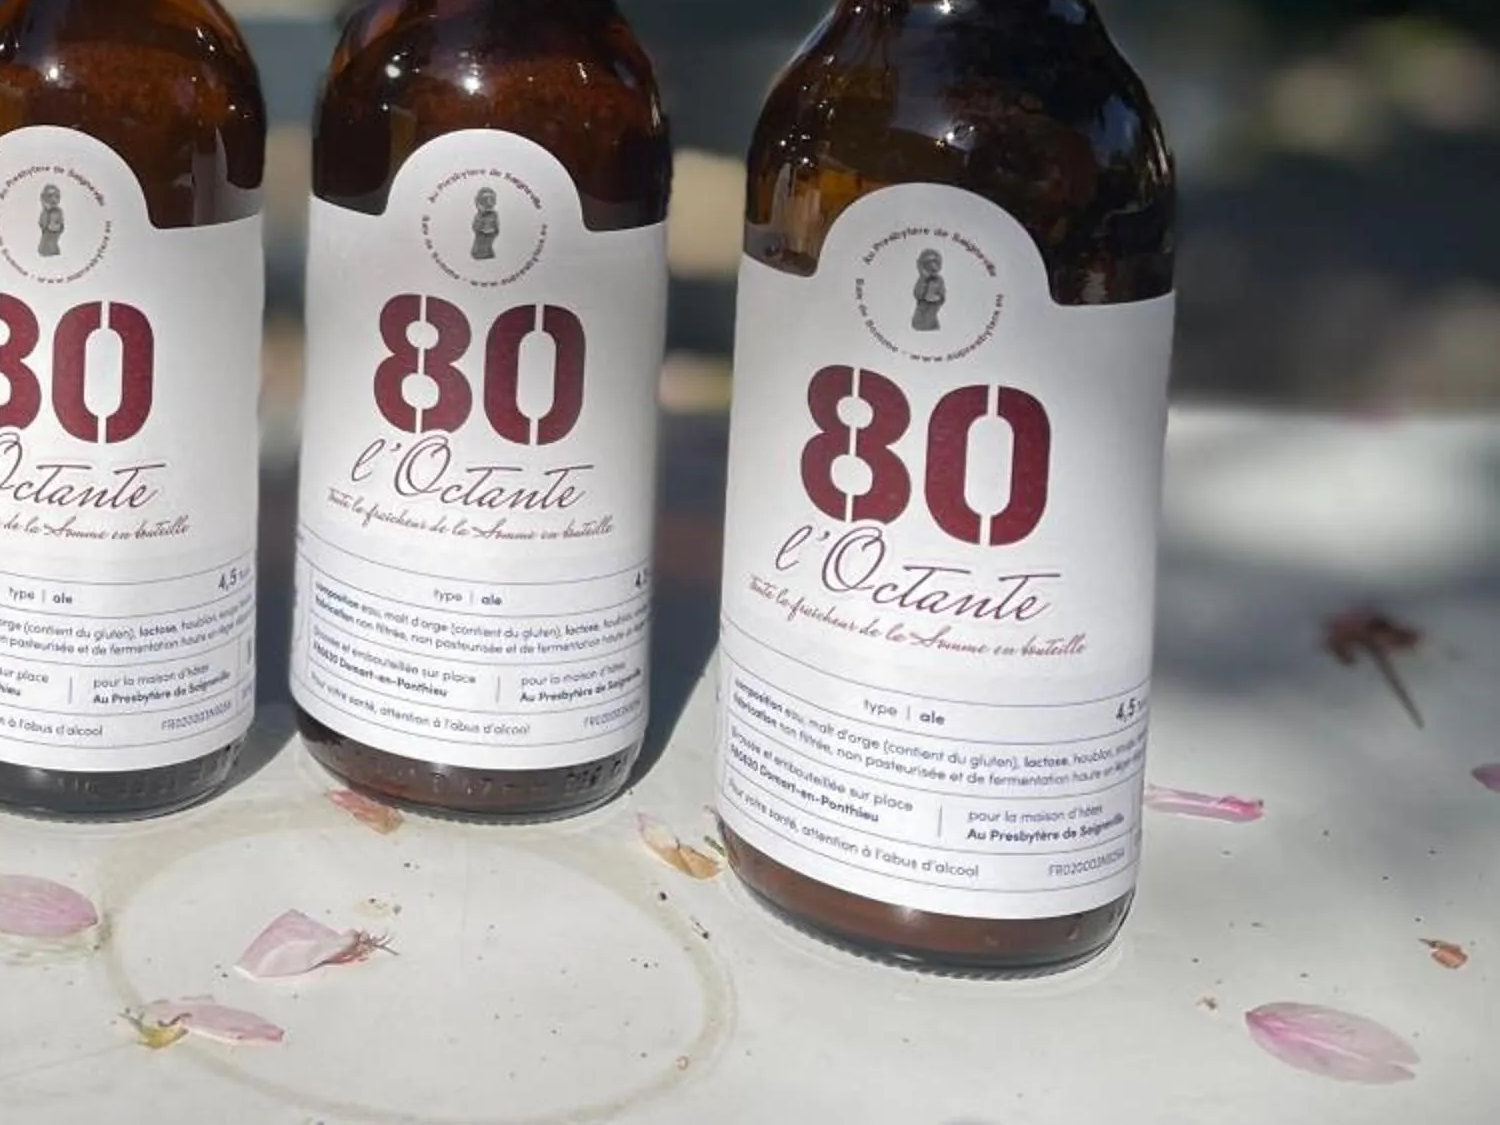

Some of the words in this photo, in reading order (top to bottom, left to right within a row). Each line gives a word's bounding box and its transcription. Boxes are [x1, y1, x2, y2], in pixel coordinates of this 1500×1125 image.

[373, 294, 586, 445] 80
[800, 364, 1051, 546] 80
[351, 435, 594, 510] l'Octante
[774, 525, 1061, 621] l'Octante
[9, 587, 34, 600] type
[52, 594, 73, 604] ale
[434, 588, 463, 602] type
[481, 595, 502, 605] ale
[76, 630, 90, 639] du
[411, 634, 432, 646] non
[504, 628, 518, 638] du
[93, 693, 108, 704] Au
[520, 693, 535, 702] Au
[864, 699, 898, 716] type
[919, 711, 945, 725] ale
[838, 730, 880, 749] d'orge
[948, 753, 965, 764] du
[837, 748, 862, 762] non
[949, 771, 963, 781] et
[967, 773, 984, 784] de
[850, 787, 869, 799] sur
[874, 795, 913, 812] place
[967, 811, 1001, 824] pour
[1005, 810, 1017, 822] la
[968, 828, 986, 840] Au
[1063, 827, 1076, 838] de
